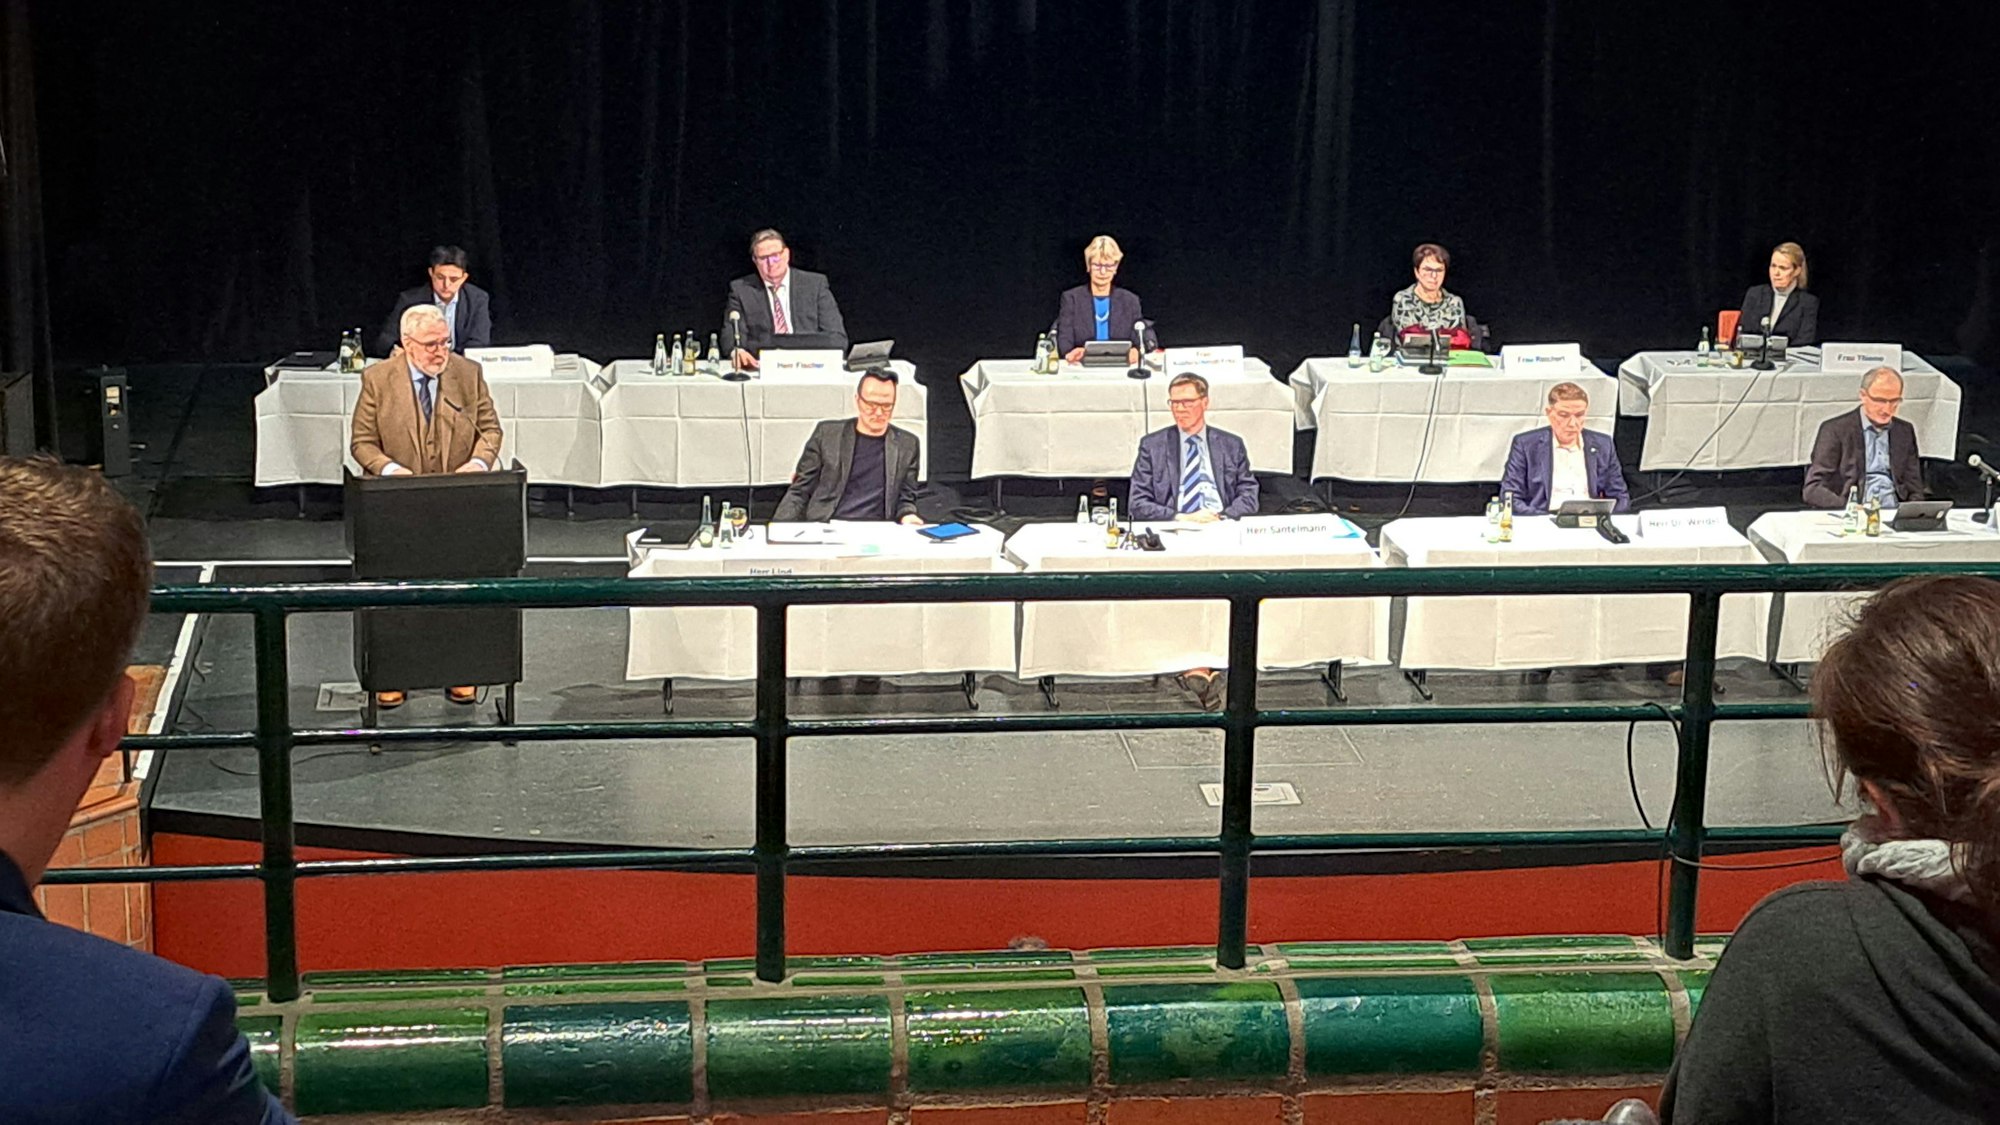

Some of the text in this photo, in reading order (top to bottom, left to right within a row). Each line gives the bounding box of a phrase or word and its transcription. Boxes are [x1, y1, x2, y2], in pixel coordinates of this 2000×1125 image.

[1837, 353, 1856, 361] Frau
[1246, 524, 1327, 534] Herr Santelmann
